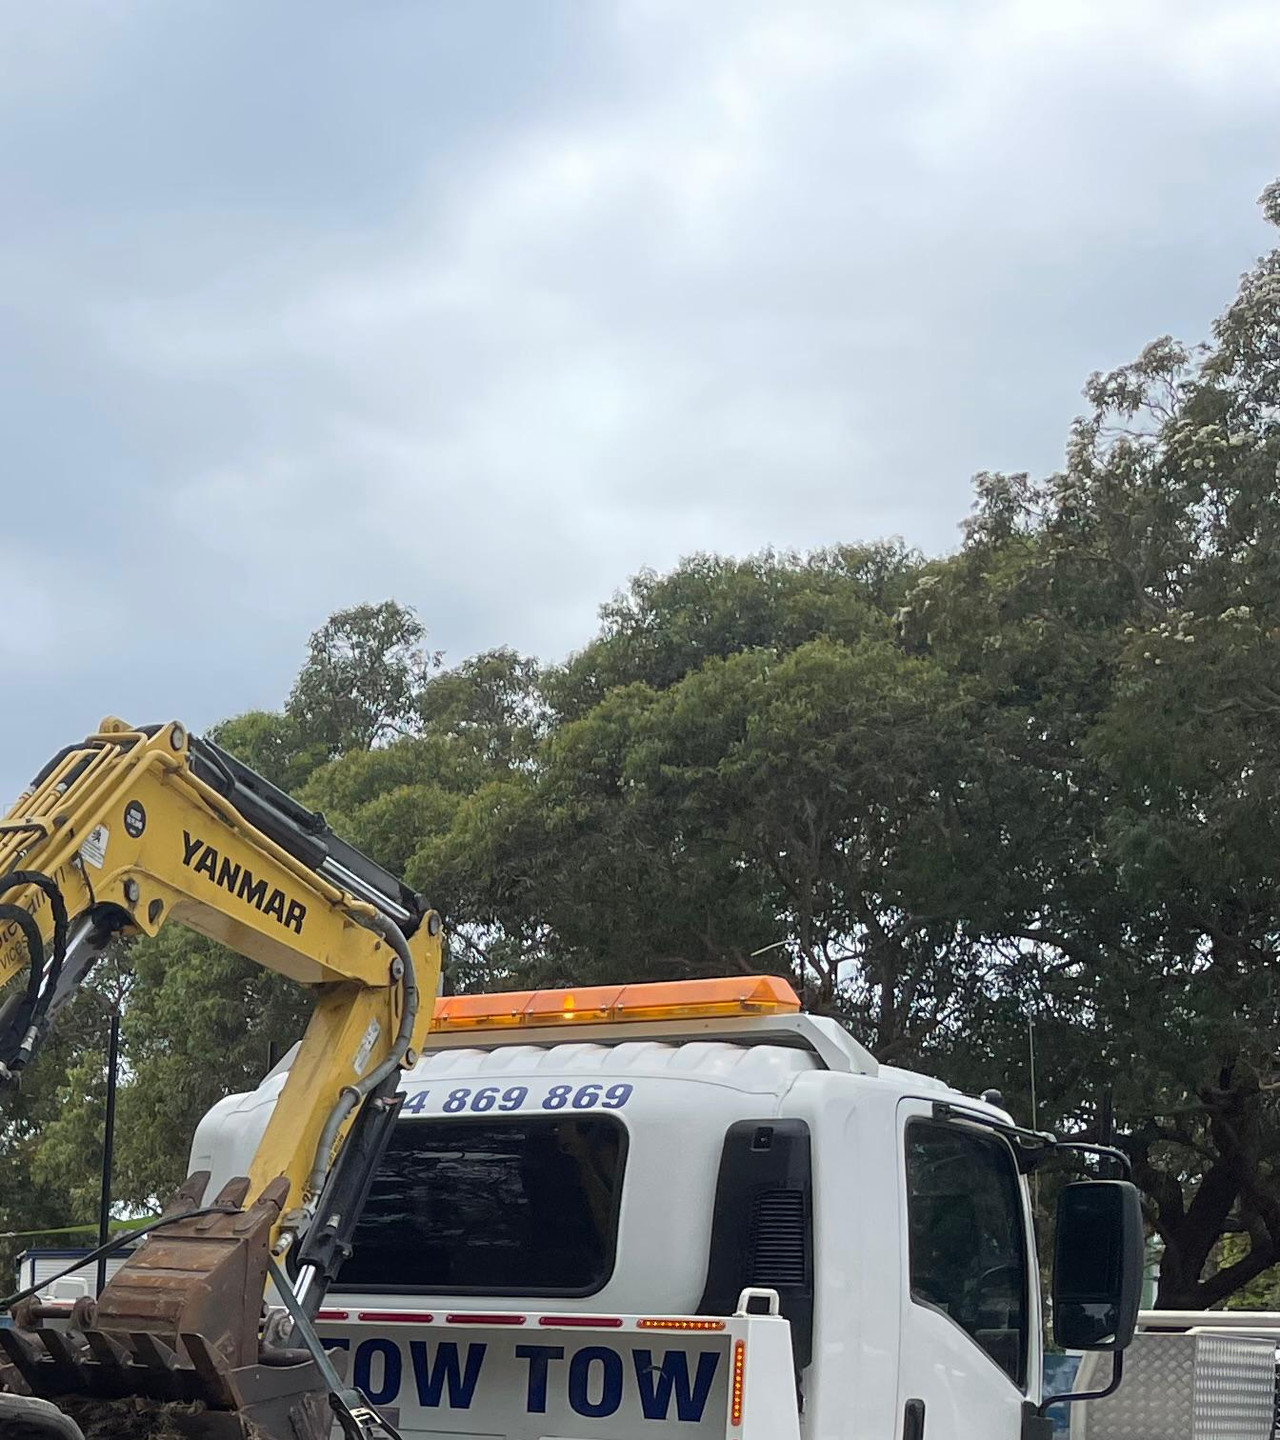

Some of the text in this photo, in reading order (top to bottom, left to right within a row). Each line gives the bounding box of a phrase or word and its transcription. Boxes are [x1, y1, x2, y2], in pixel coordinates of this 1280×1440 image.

[182, 830, 307, 935] YANMAR
[442, 1086, 529, 1113] 869
[542, 1083, 634, 1110] 869
[515, 1344, 721, 1423] TOW
